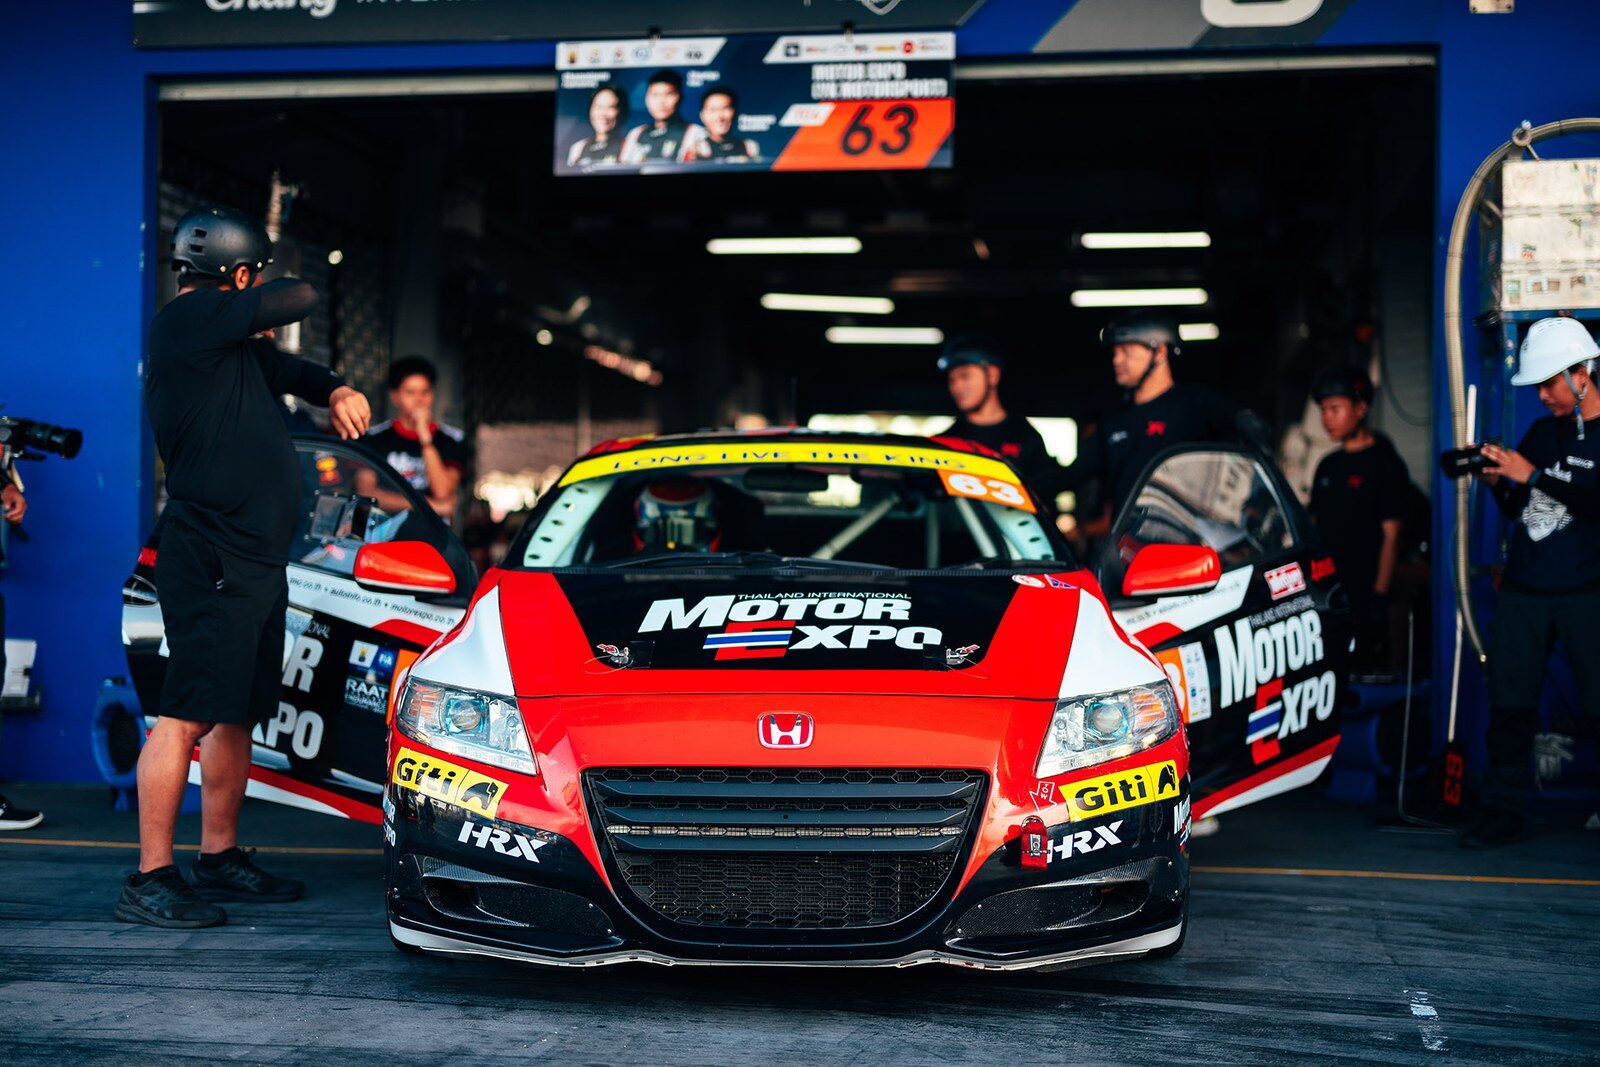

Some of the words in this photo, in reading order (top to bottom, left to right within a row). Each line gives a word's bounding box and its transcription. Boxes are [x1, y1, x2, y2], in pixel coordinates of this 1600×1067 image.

[840, 104, 917, 156] 63
[614, 452, 706, 470] LONG
[721, 450, 792, 462] LIVE
[812, 451, 870, 463] THE
[886, 454, 967, 470] KING
[948, 473, 1025, 505] 63
[637, 595, 912, 633] MOTOR
[808, 592, 912, 600] INTERNATIONAL
[702, 620, 943, 661] EXPO
[1214, 609, 1324, 709] MOTOR
[346, 678, 389, 699] RAAT
[1246, 670, 1337, 766] EXPO
[397, 757, 457, 796] Giti
[1040, 783, 1049, 800] TOW
[1075, 774, 1147, 811] Giti
[457, 820, 548, 863] HRX
[1047, 819, 1124, 864] HRX
